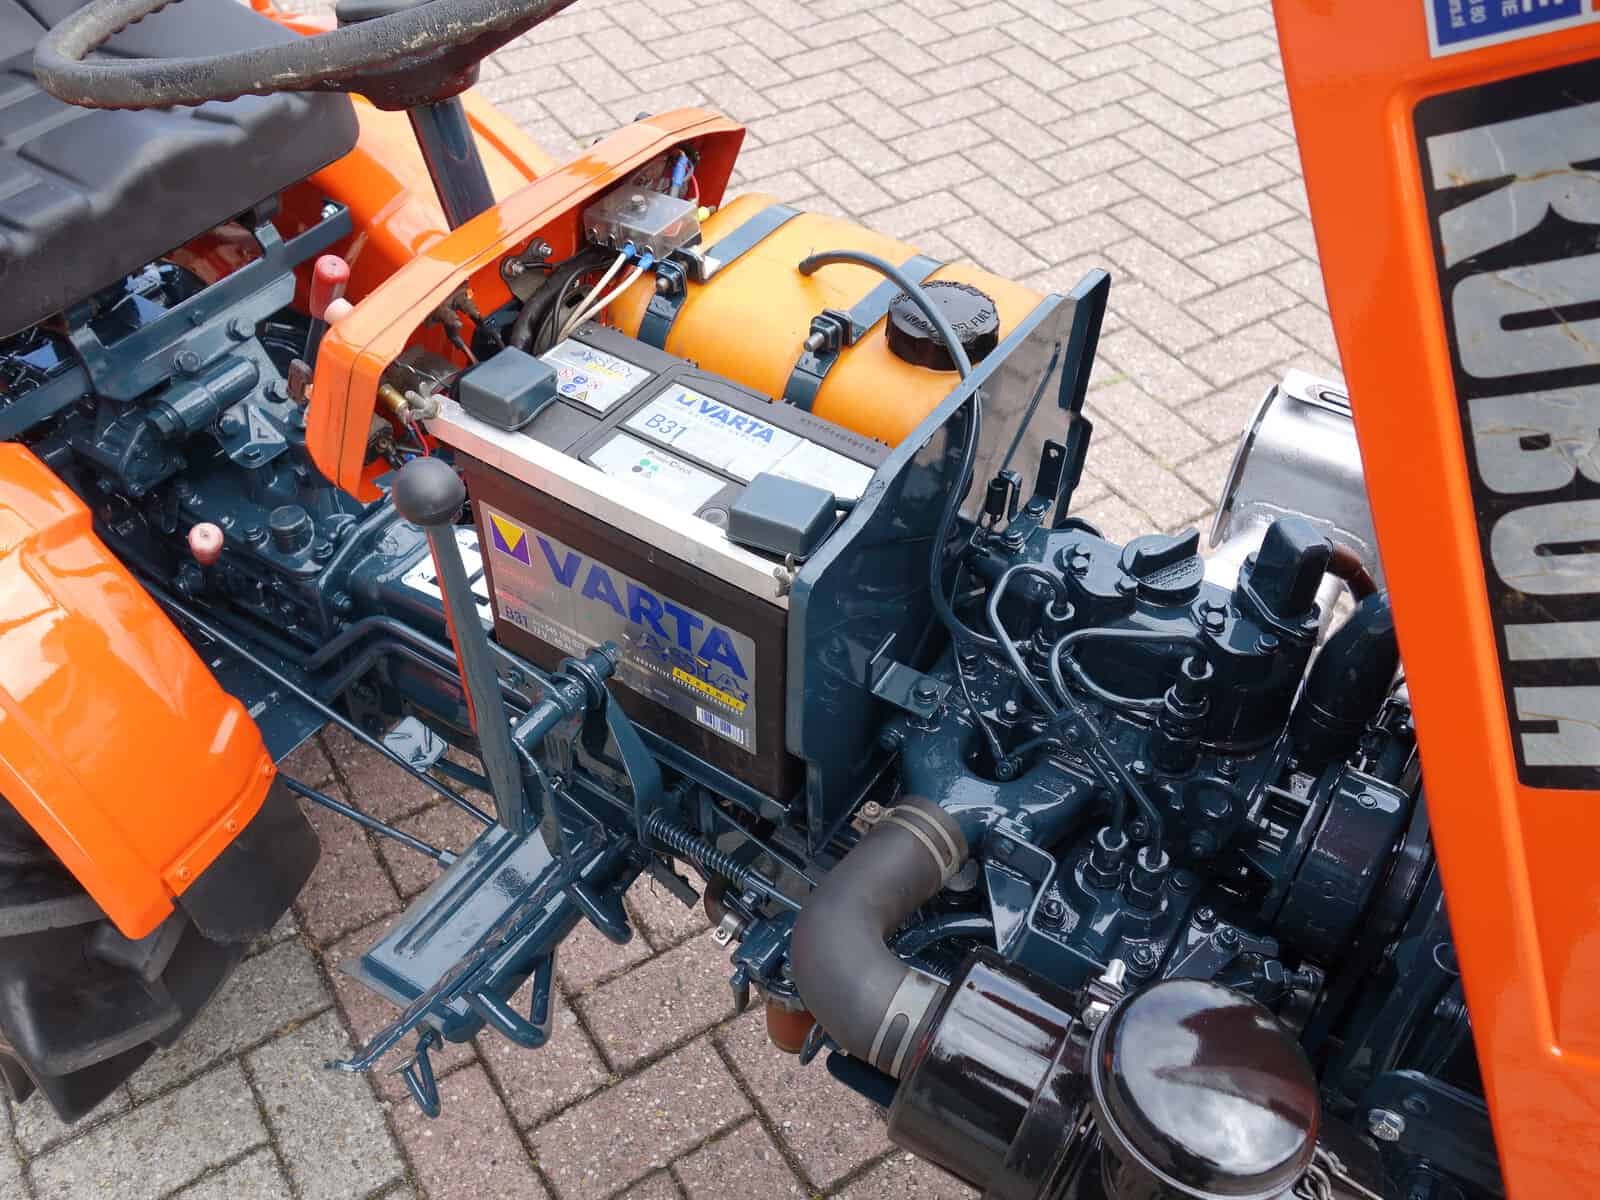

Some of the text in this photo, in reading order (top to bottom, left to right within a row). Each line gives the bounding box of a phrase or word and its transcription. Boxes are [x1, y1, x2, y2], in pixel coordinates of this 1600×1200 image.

[644, 413, 688, 444] B31
[696, 399, 776, 444] VARTA
[535, 535, 749, 681] VARTA
